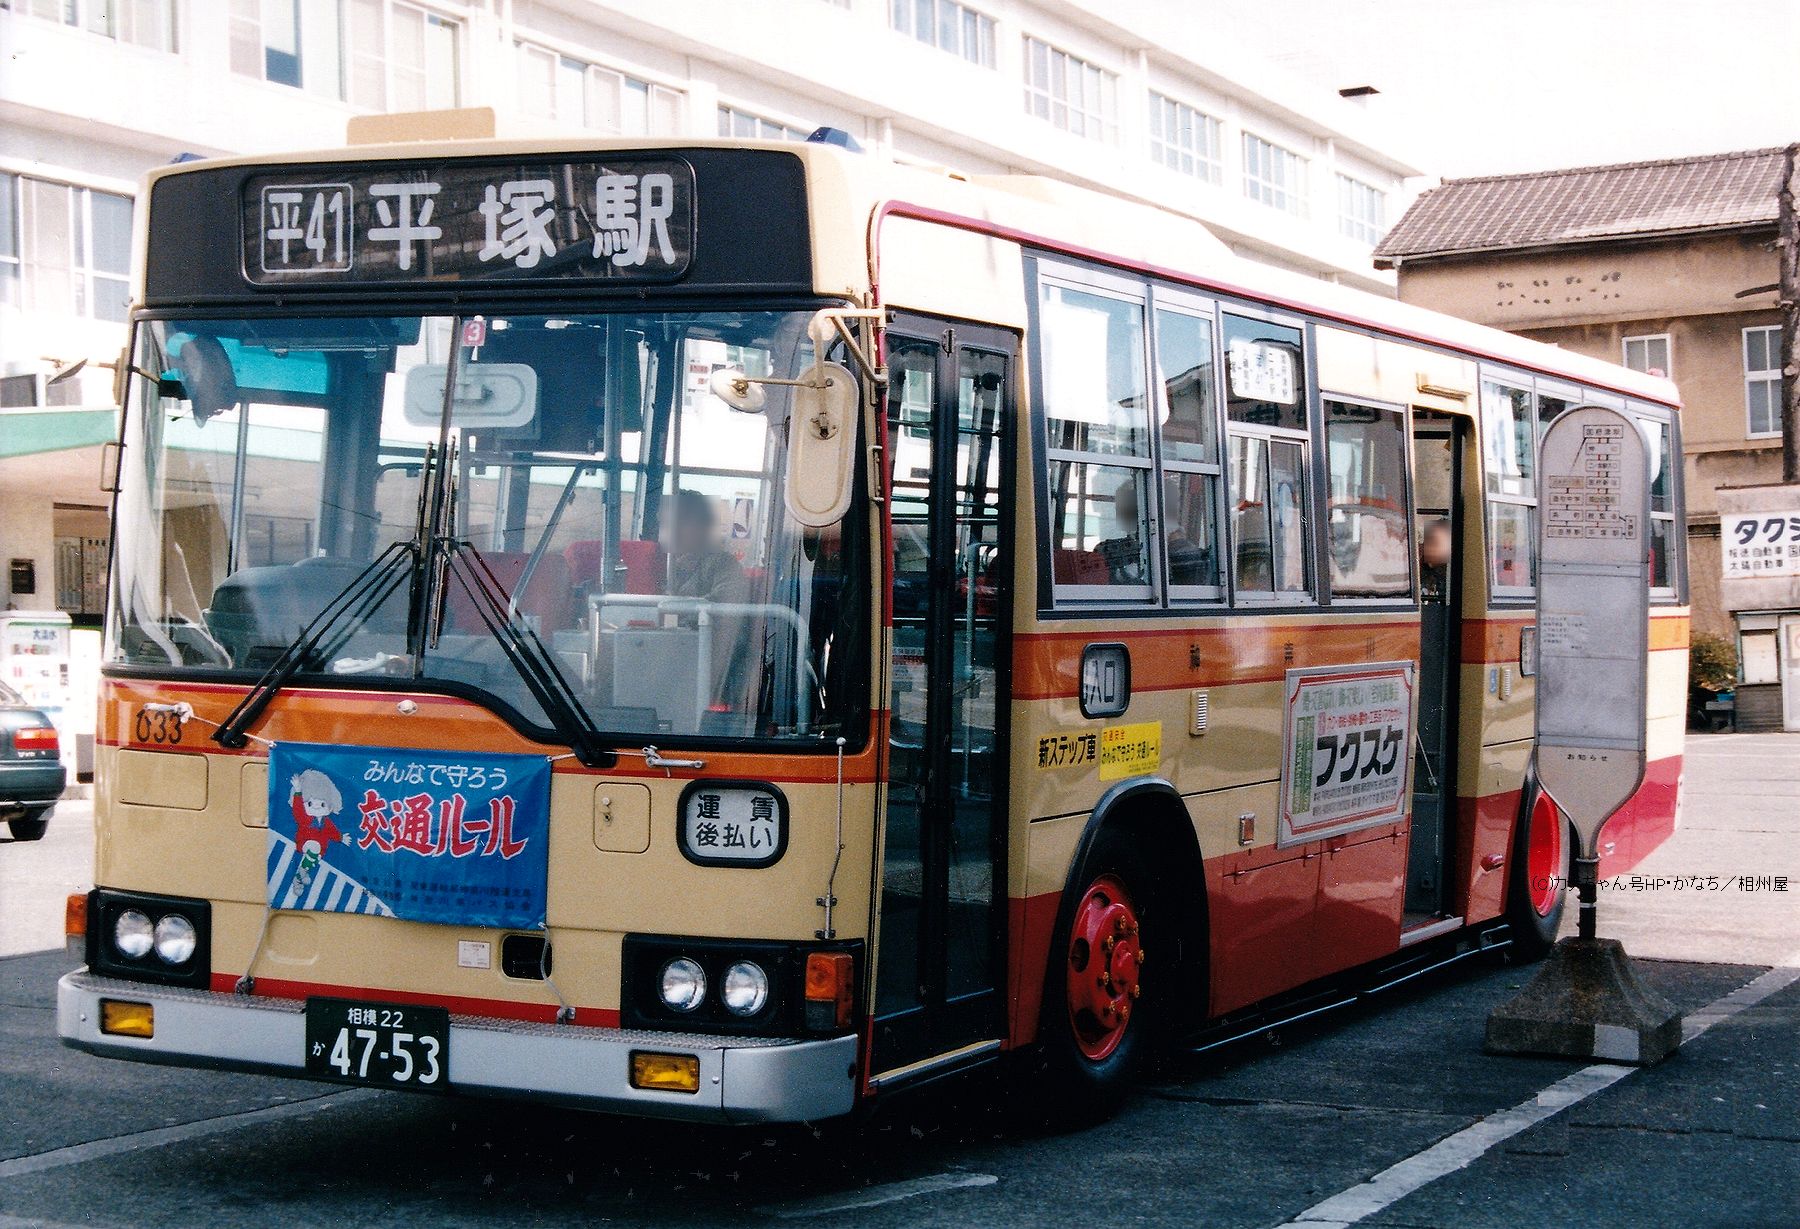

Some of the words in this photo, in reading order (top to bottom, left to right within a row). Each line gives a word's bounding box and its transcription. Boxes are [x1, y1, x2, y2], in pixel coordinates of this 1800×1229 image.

[268, 191, 343, 264] 平41
[368, 173, 676, 271] 平塚駅
[468, 323, 481, 341] 3
[1038, 732, 1097, 768] 新ステップ車
[1316, 724, 1403, 787] フクスケ
[364, 760, 508, 790] みんなで守ろう
[357, 788, 529, 860] 交通ルール
[697, 795, 774, 822] 運賃
[696, 822, 773, 848] 後払い
[348, 1008, 377, 1026] 相模
[380, 1010, 404, 1028] 22
[312, 1041, 326, 1057] か
[330, 1027, 440, 1084] 47-53
